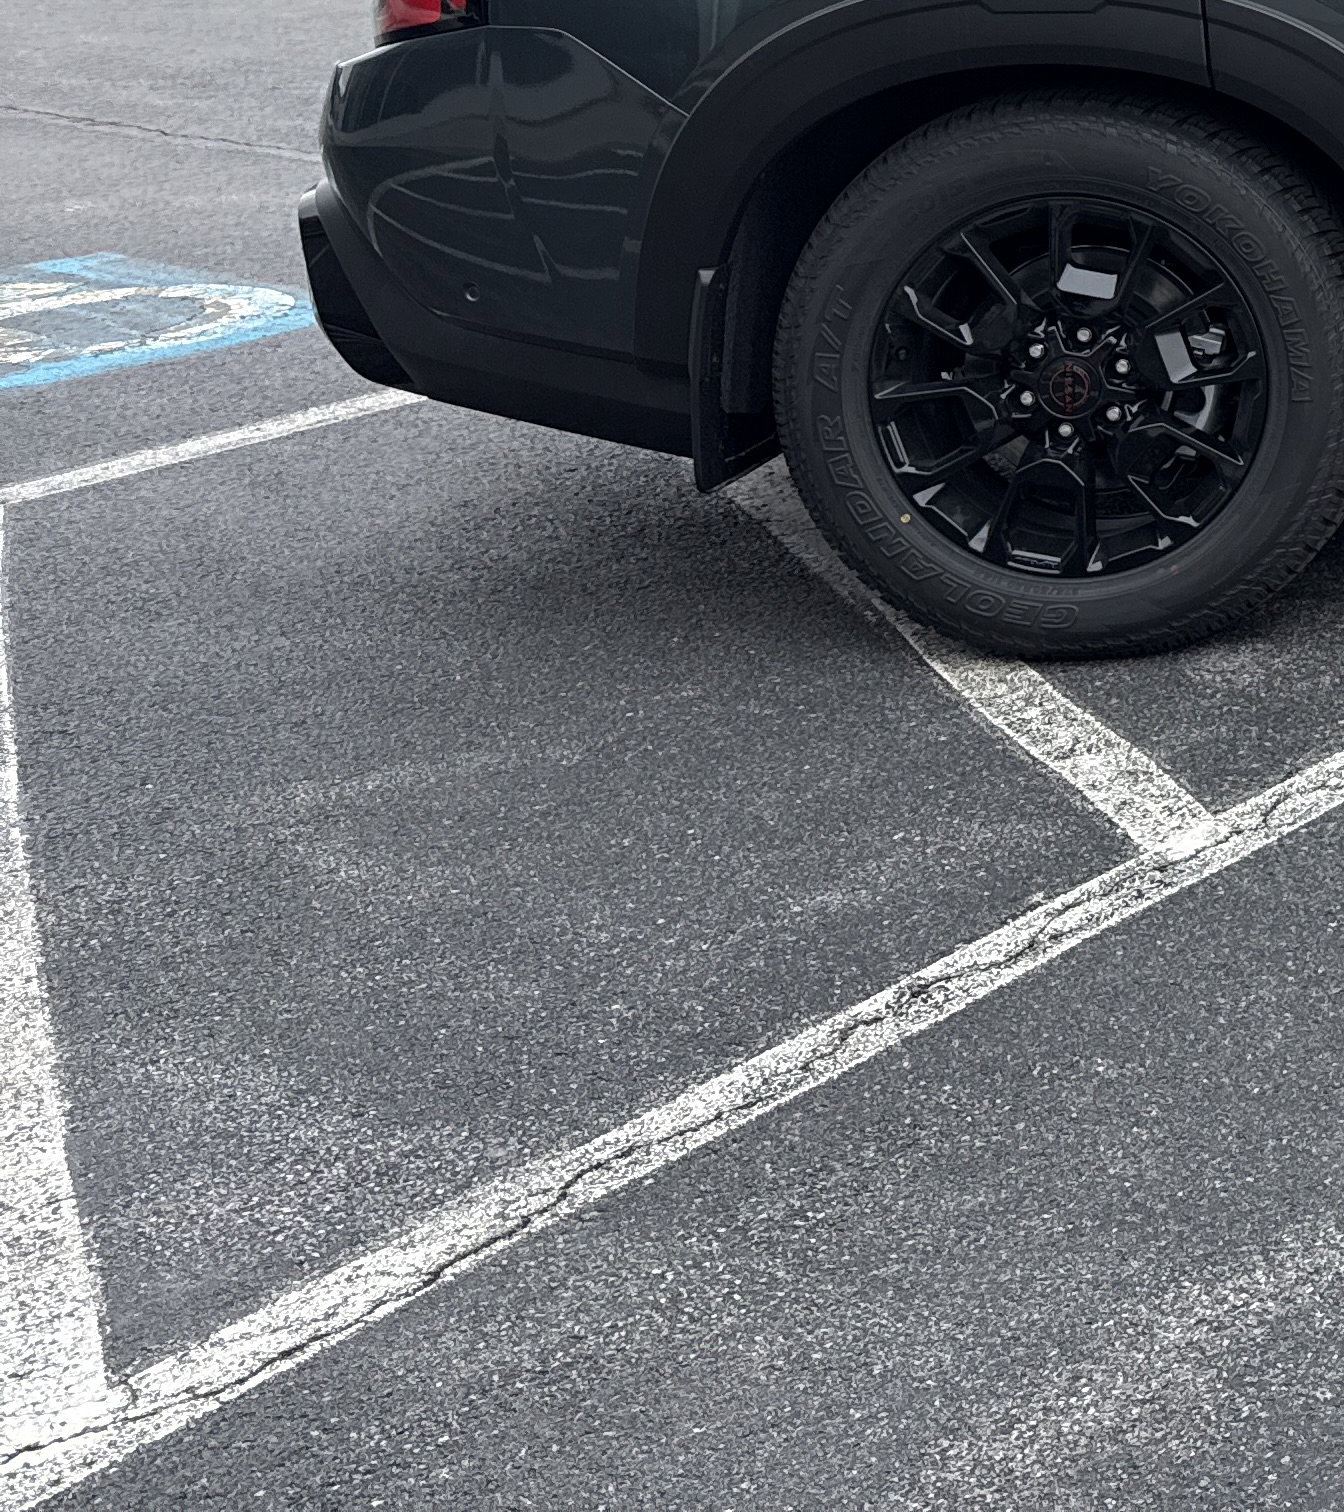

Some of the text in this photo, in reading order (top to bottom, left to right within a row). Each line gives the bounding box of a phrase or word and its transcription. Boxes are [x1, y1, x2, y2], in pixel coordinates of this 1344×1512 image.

[813, 284, 857, 393] A/T
[1144, 165, 1314, 404] YOKOHAMA
[816, 412, 1080, 632] GEOLANDAR
